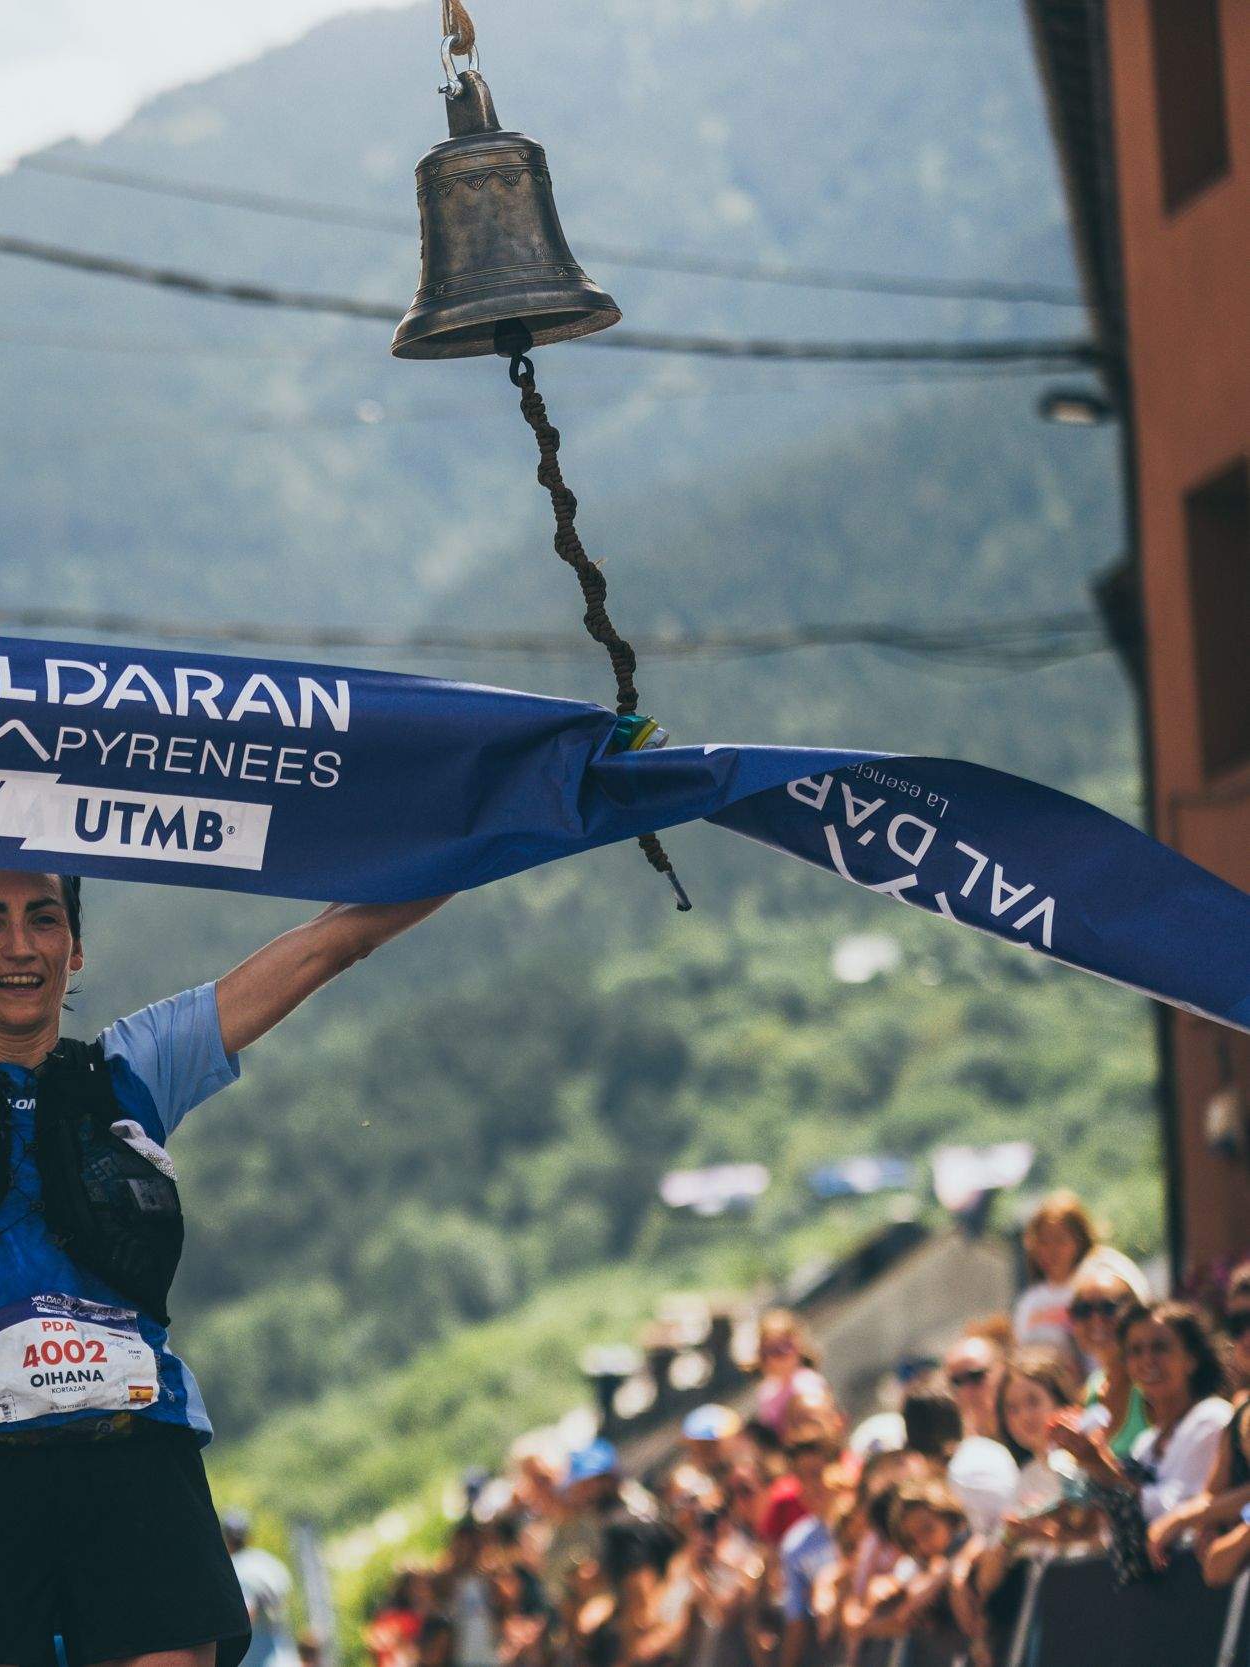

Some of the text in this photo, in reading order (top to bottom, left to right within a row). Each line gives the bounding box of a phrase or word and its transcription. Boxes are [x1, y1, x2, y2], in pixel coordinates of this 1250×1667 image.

[54, 726, 343, 789] PYRENEES
[926, 792, 949, 818] La
[786, 774, 1056, 950] VAL D'AR
[42, 1321, 77, 1332] PDA
[23, 1340, 108, 1369] 4002
[30, 1369, 105, 1388] OIHANA
[51, 1385, 87, 1394] KORTAZAR
